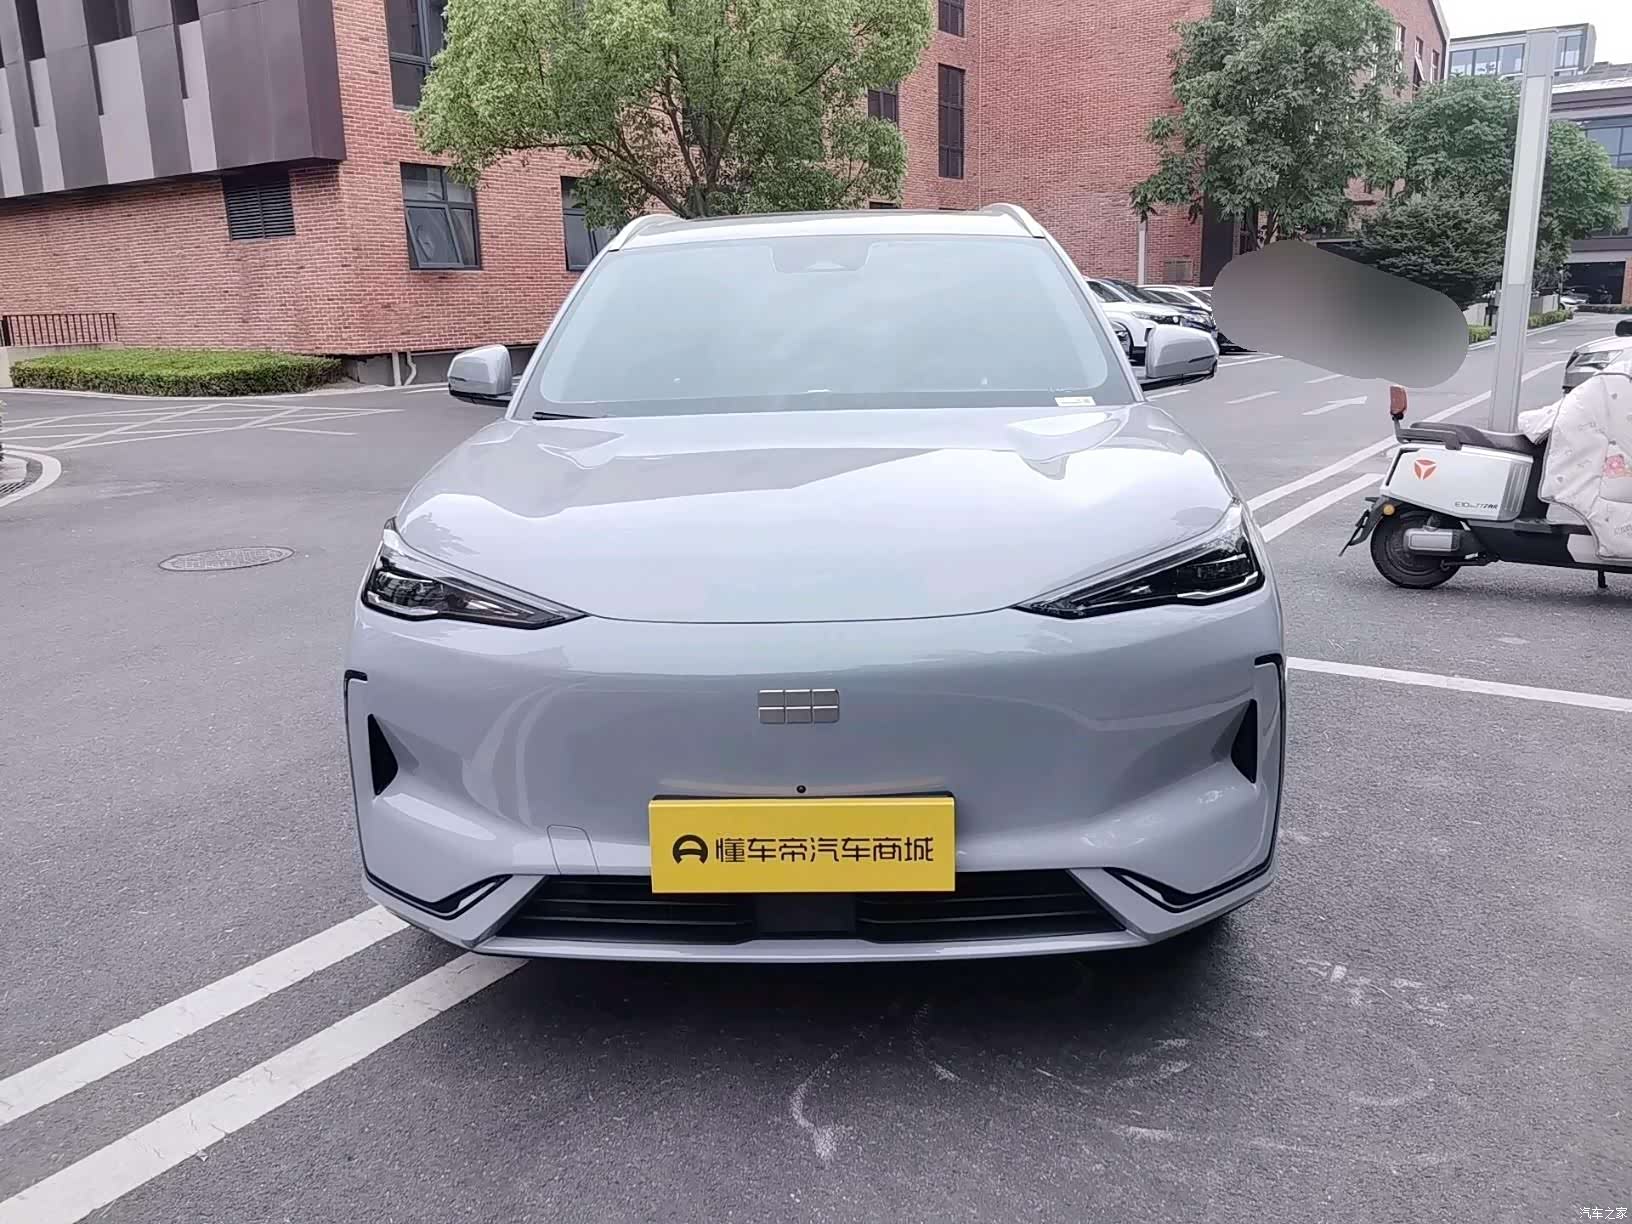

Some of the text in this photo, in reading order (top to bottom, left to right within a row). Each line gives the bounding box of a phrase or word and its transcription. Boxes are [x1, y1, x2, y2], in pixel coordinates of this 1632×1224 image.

[715, 837, 934, 863] 懂车帝汽车商城
